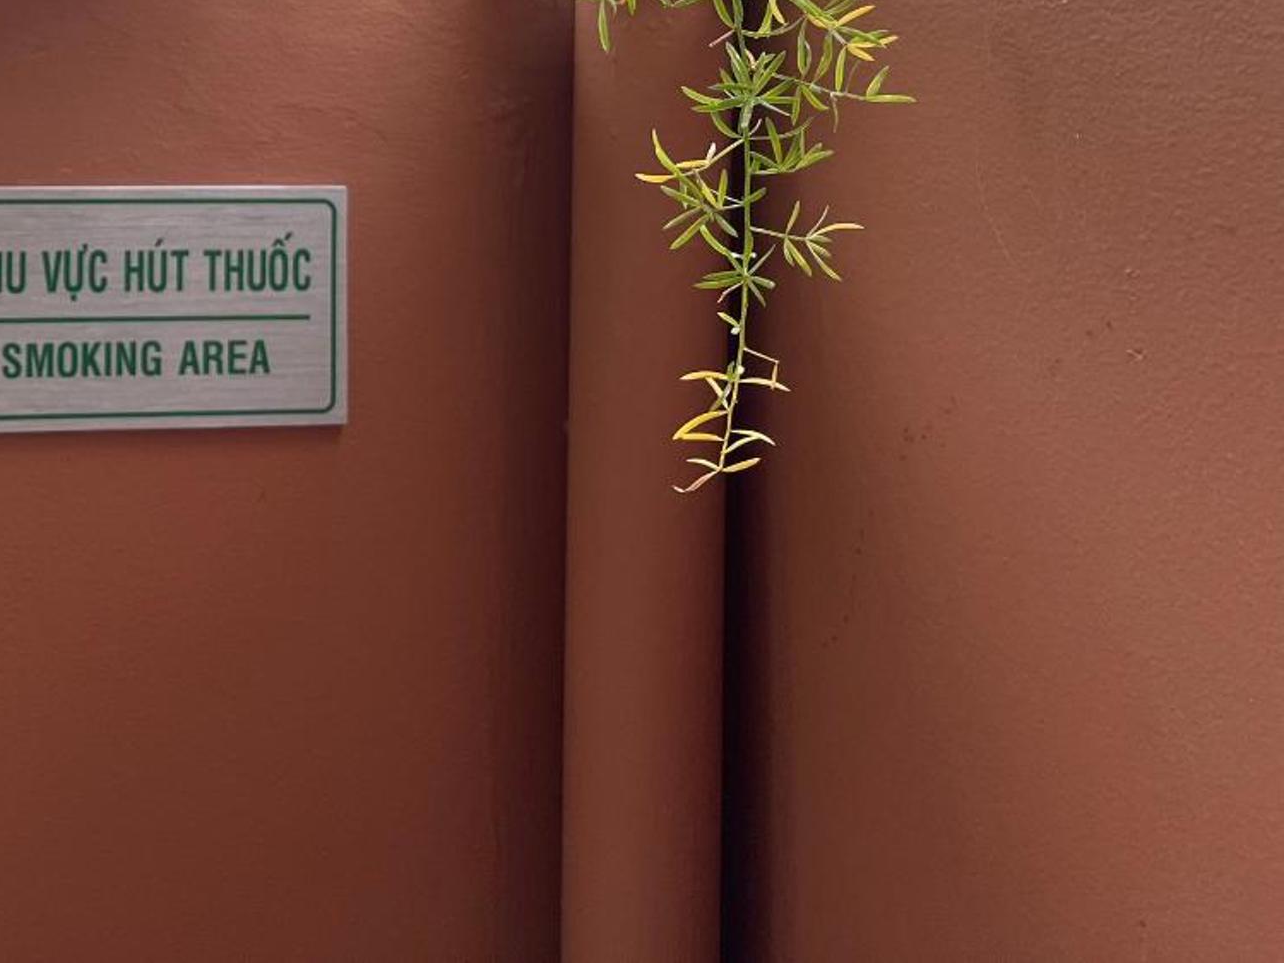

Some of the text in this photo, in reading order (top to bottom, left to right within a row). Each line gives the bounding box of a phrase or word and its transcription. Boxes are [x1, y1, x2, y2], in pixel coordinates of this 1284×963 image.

[42, 243, 109, 302] VỰC
[122, 238, 189, 293] HÚT
[204, 231, 312, 293] THUỐC
[2, 339, 271, 380] SMOKING AREA
